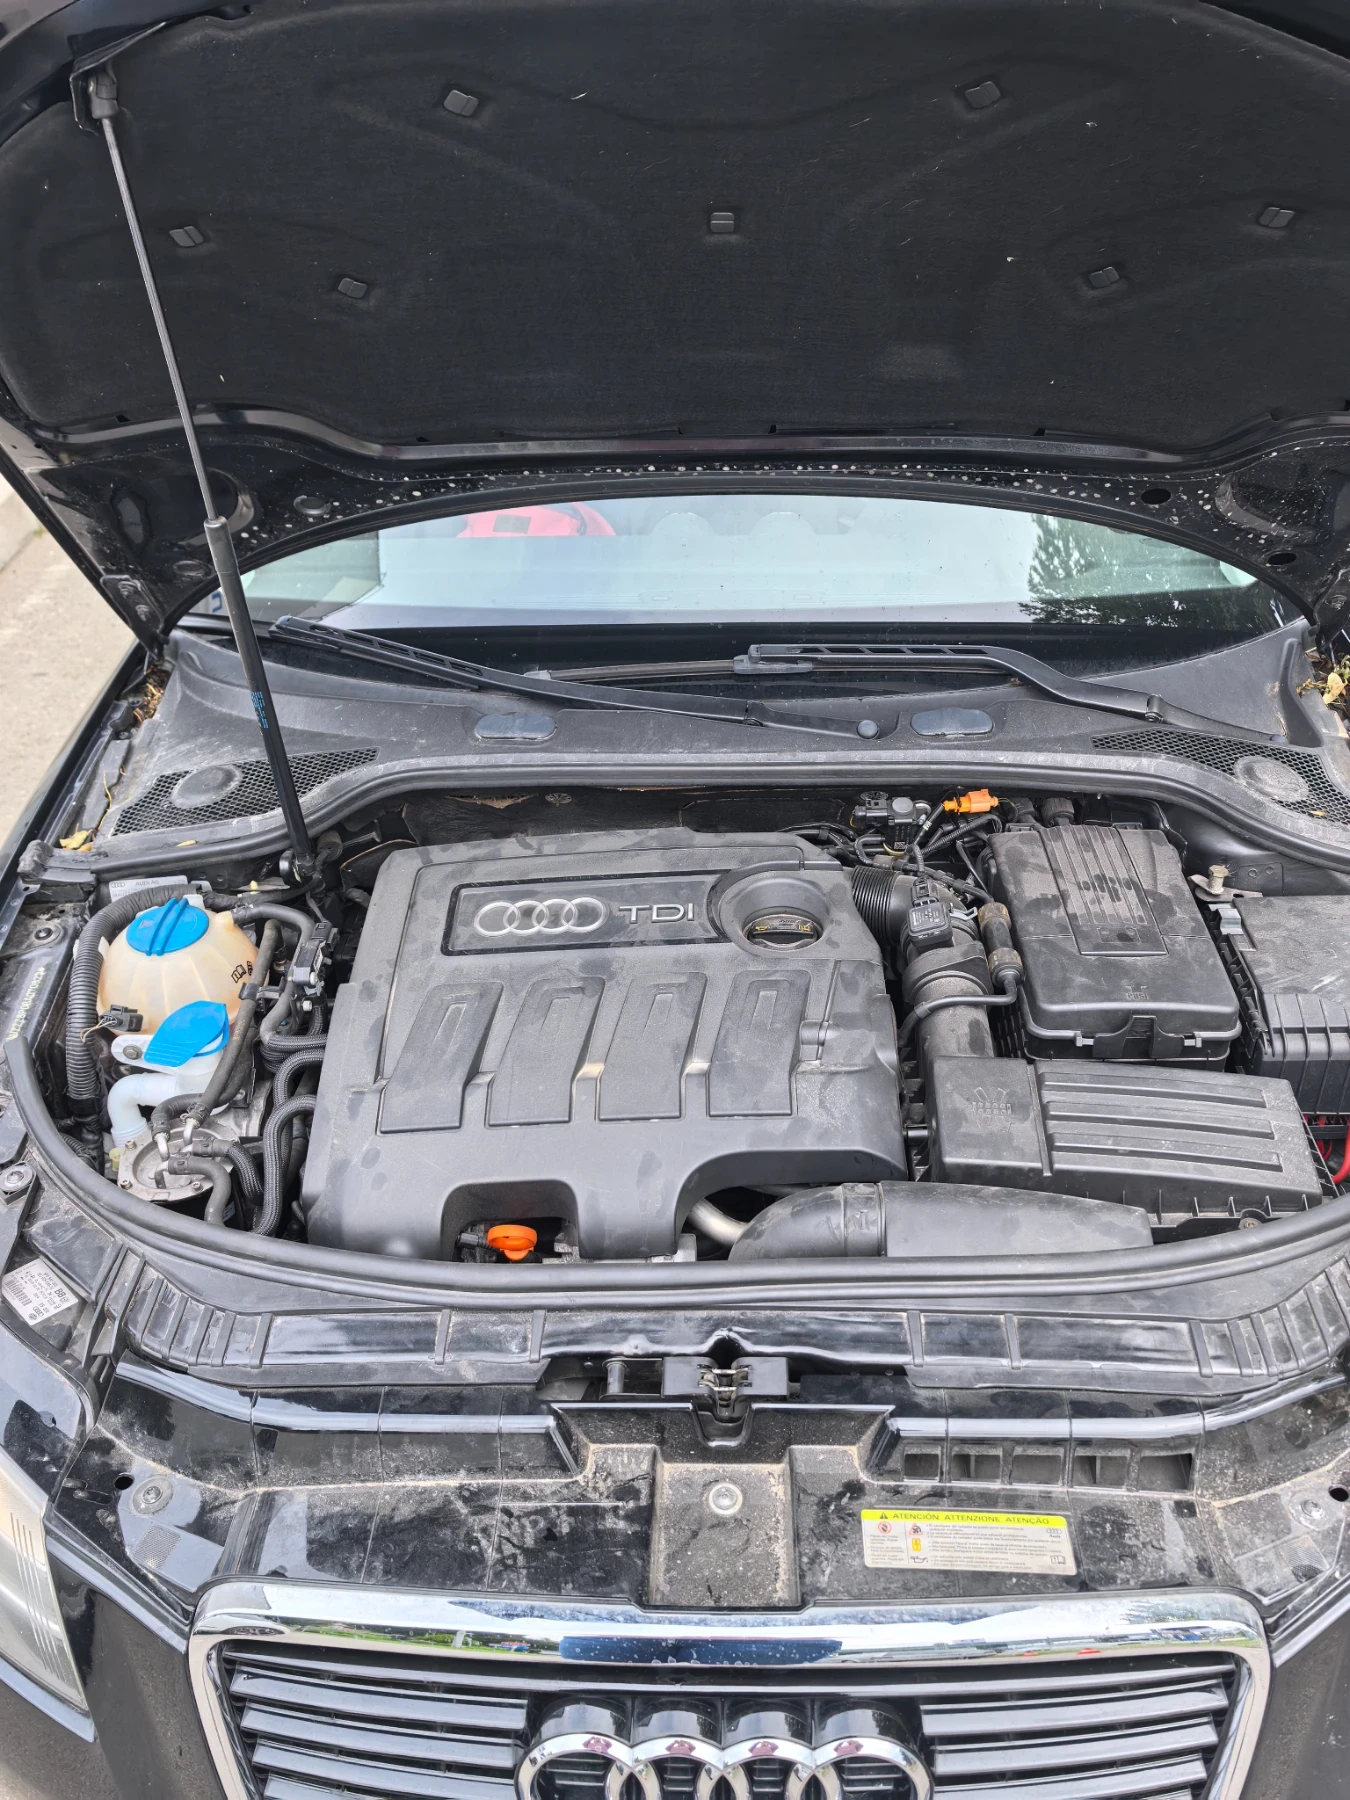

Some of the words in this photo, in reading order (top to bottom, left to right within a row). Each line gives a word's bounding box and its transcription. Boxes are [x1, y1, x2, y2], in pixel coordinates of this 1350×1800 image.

[619, 903, 694, 924] TDI
[893, 1512, 939, 1520] ATENCIÓN
[944, 1514, 1000, 1523] ATTENZIONE
[1005, 1516, 1049, 1525] ATENÇÃO
